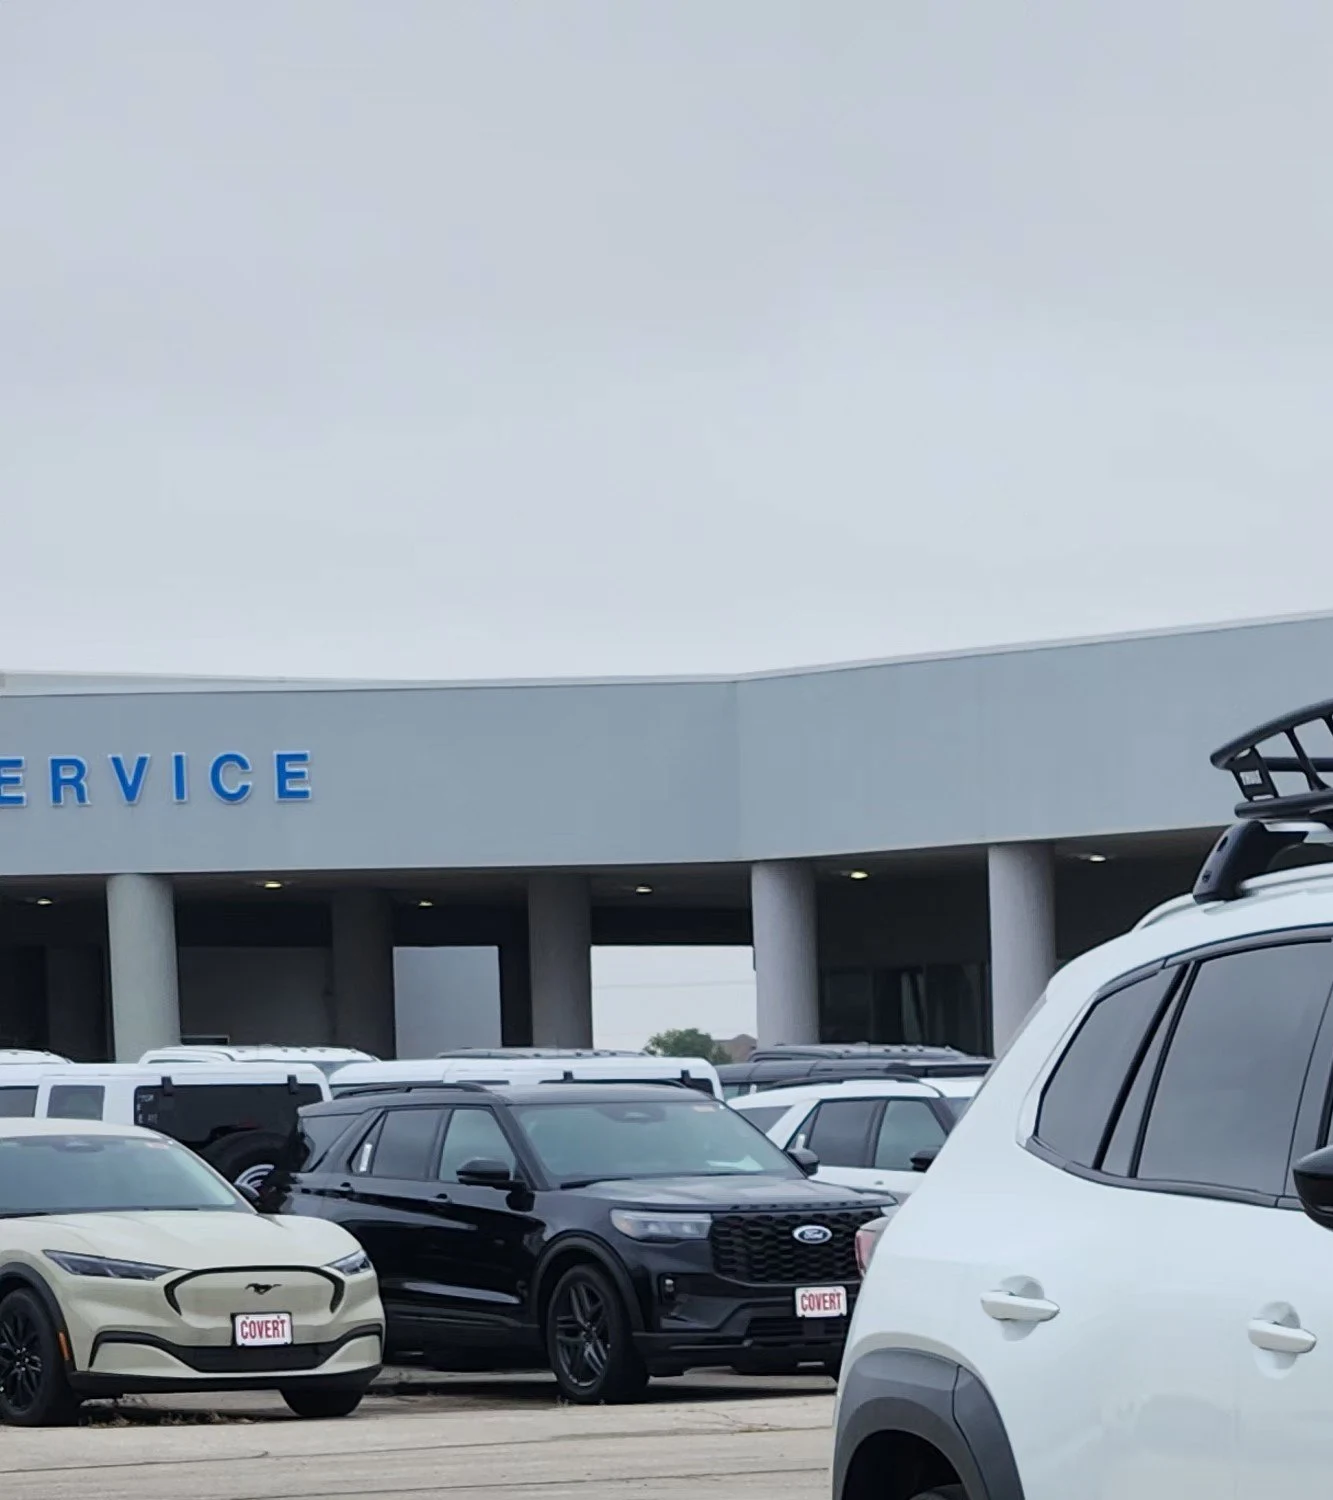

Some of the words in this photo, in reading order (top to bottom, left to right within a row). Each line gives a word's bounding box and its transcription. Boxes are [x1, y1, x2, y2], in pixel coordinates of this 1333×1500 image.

[0, 750, 311, 806] ERVICE
[800, 1292, 842, 1312] COVERT
[240, 1319, 286, 1340] COVERT
